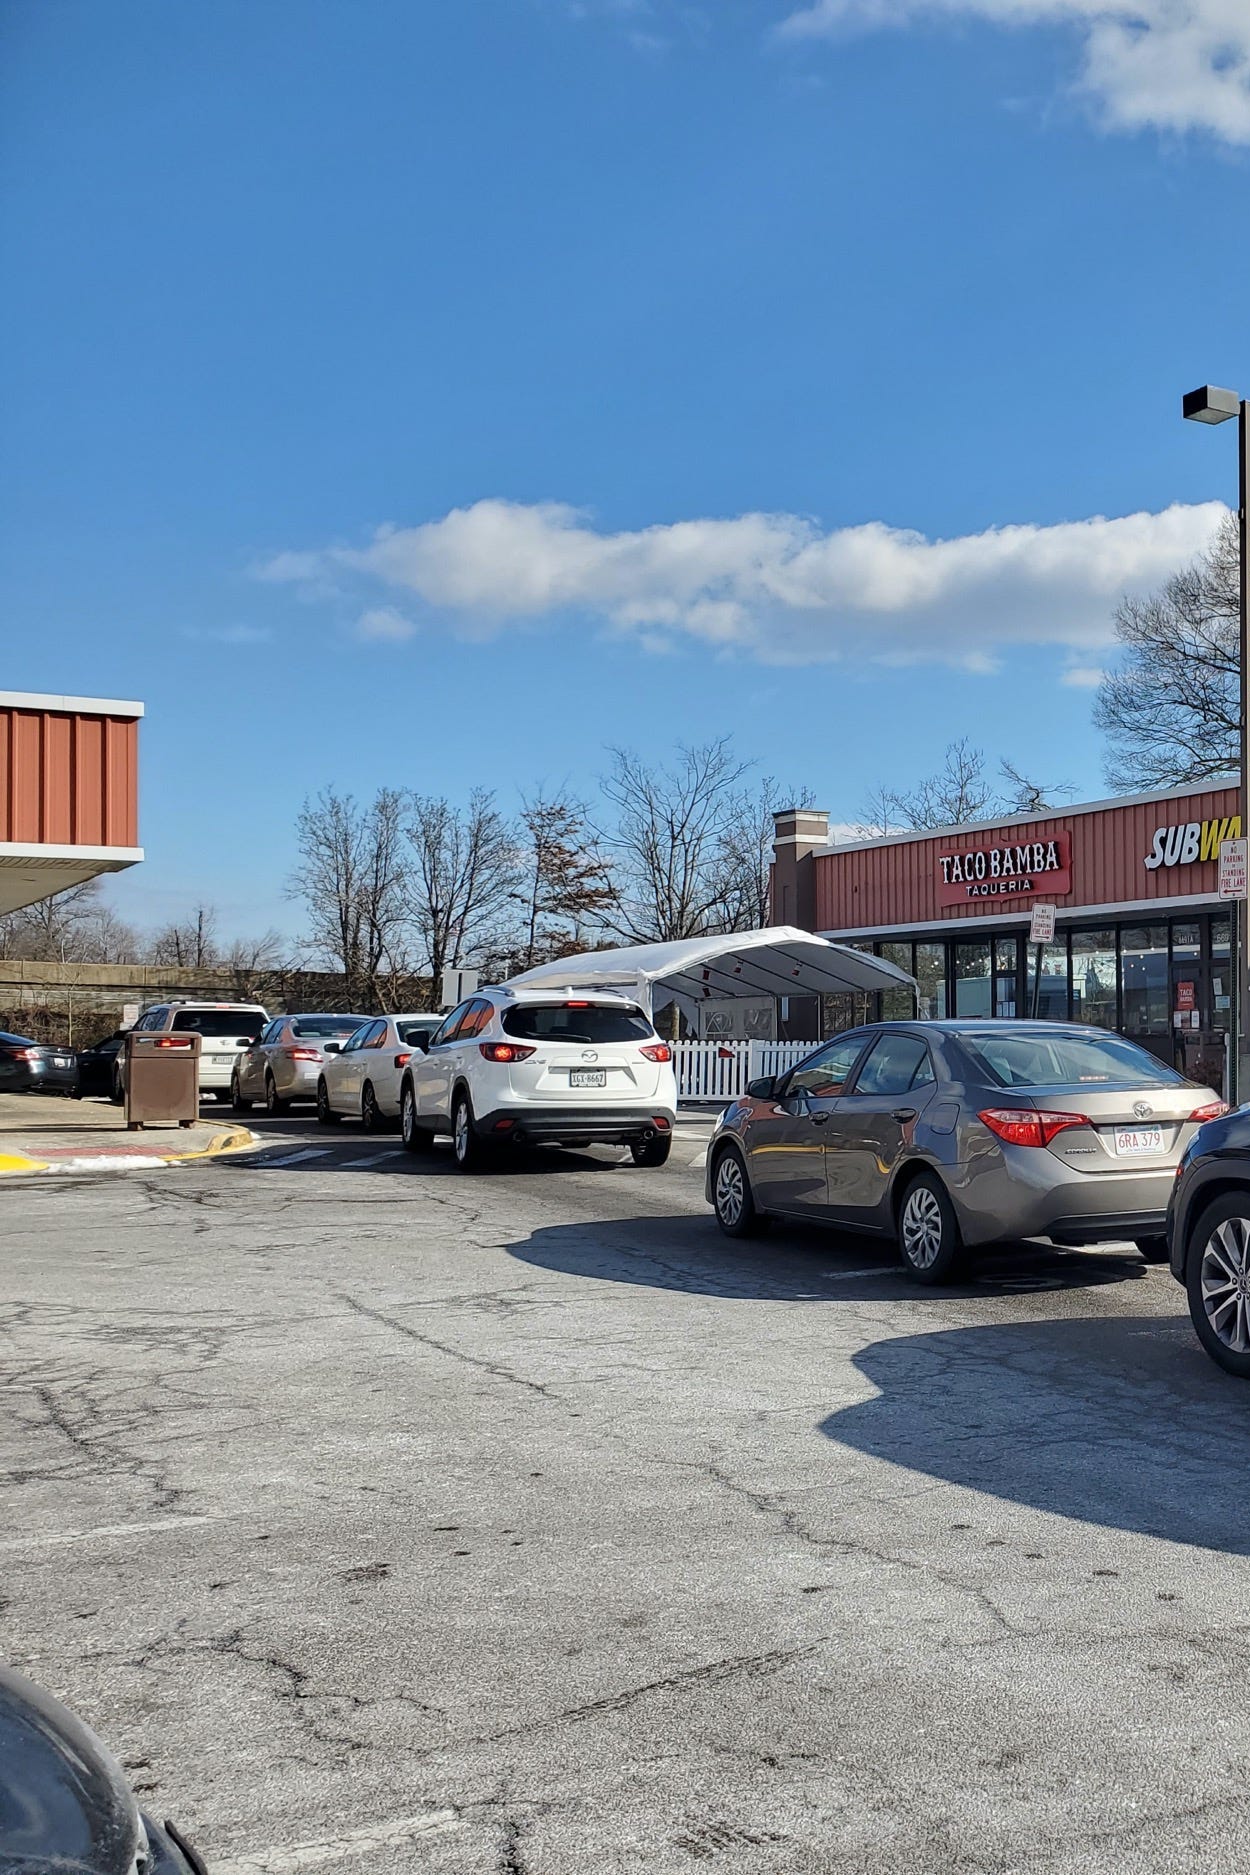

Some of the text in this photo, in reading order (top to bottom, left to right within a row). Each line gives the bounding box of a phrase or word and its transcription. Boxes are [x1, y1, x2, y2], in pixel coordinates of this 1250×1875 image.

[1230, 846, 1237, 854] NO
[939, 840, 1059, 884] TACO BAMBA
[1223, 855, 1244, 863] PARKING
[1222, 868, 1245, 877] STANDING
[965, 879, 1032, 897] TAQUERIA
[1221, 877, 1246, 888] FIRE LANE
[1118, 1131, 1161, 1149] 6RA 379
